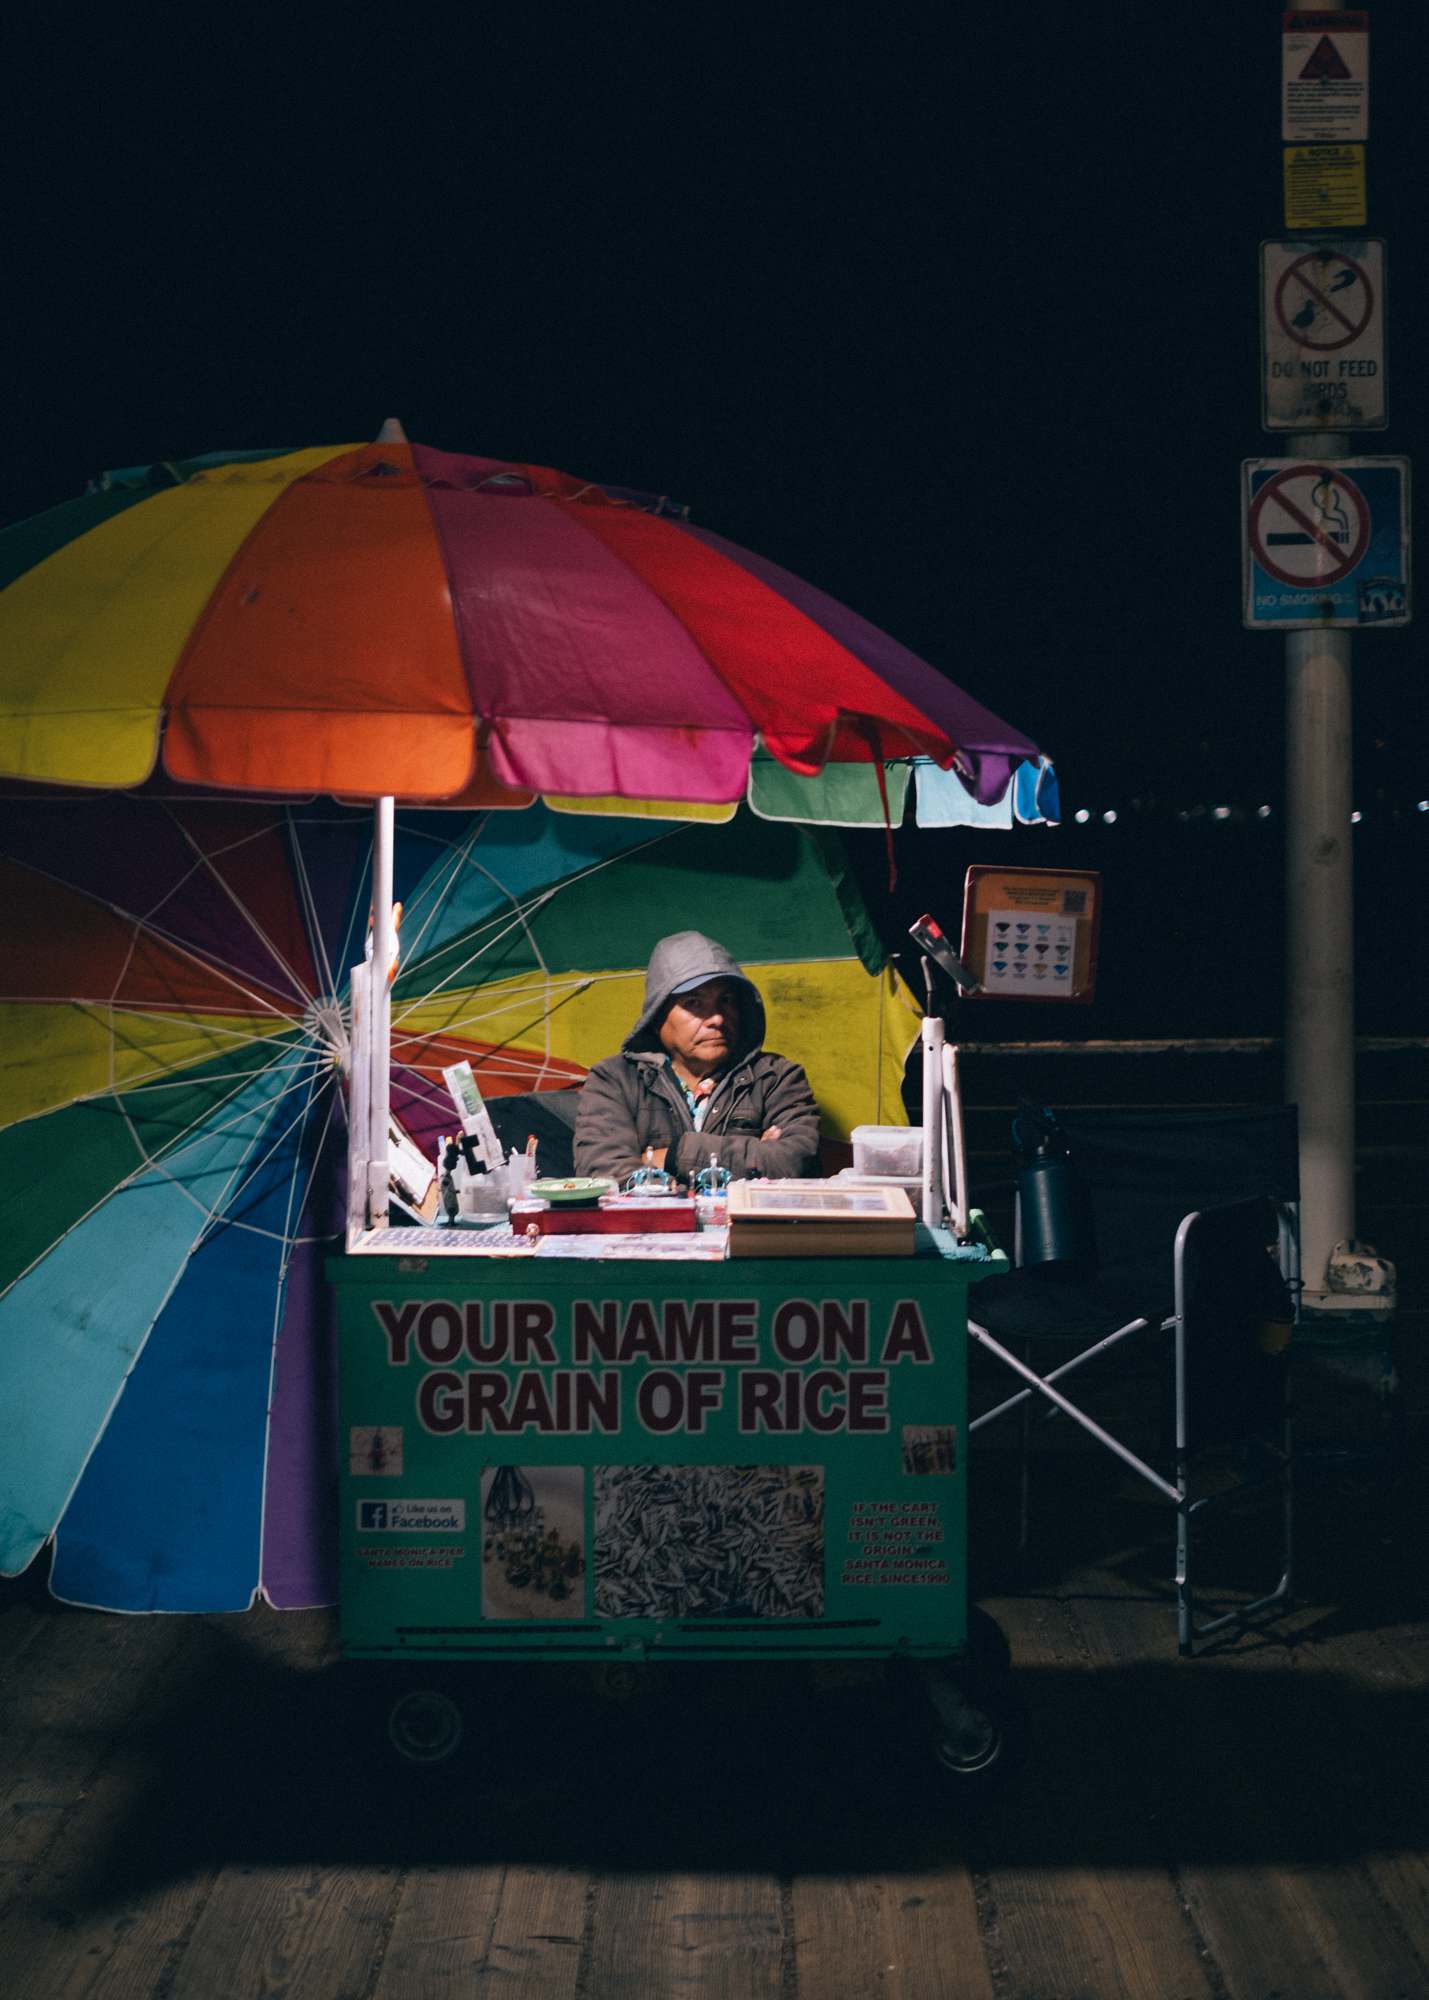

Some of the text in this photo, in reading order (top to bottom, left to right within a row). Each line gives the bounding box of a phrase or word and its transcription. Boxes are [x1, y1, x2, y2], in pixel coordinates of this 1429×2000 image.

[1272, 360, 1377, 378] DO NOT FEED
[1304, 383, 1347, 400] RDS
[1255, 594, 1277, 606] NO
[371, 1298, 934, 1366] YOUR NAME ON A
[416, 1368, 891, 1436] GRAIN OF RICE
[406, 1505, 425, 1514] Like
[427, 1506, 438, 1514] us
[440, 1506, 452, 1514] on
[853, 1503, 937, 1512] IF THE CART
[392, 1515, 458, 1528] Facebook
[852, 1517, 884, 1526] ISN'T
[850, 1531, 944, 1541] IT IS NOT THE
[846, 1559, 945, 1569] SANTA MONICA
